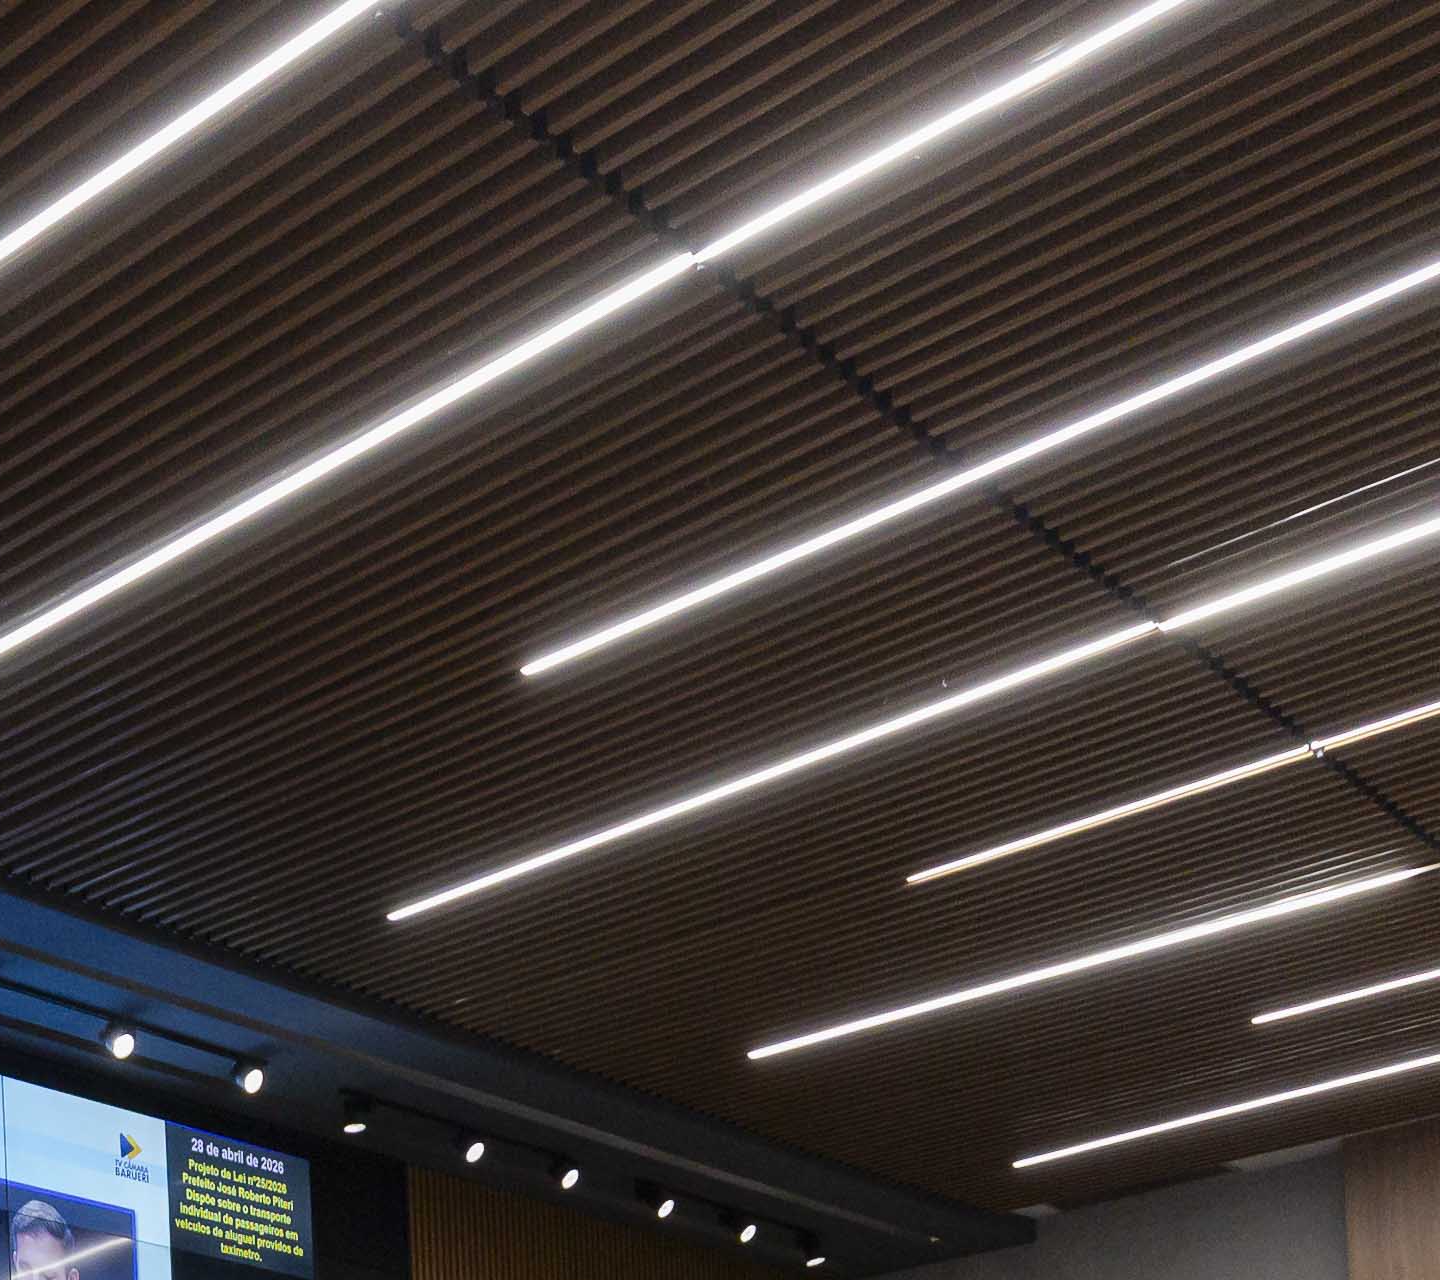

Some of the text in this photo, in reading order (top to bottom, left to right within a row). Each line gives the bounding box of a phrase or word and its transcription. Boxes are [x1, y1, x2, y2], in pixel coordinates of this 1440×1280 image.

[191, 1136, 284, 1174] 28 de abril de 2026
[115, 1167, 150, 1183] BARUERI
[188, 1158, 219, 1177] Projeto
[220, 1167, 231, 1180] de
[233, 1170, 245, 1184] Lei
[182, 1171, 215, 1191] Prefeito
[216, 1180, 236, 1196] José
[238, 1186, 271, 1205] Roberto
[217, 1197, 240, 1212] sobre
[249, 1204, 291, 1225] transporte
[212, 1225, 223, 1238] de
[224, 1228, 255, 1245] aluguel
[256, 1237, 291, 1254] providos
[292, 1244, 303, 1257] de
[222, 1212, 233, 1225] de
[234, 1217, 284, 1237] passageiros
[285, 1230, 298, 1241] em
